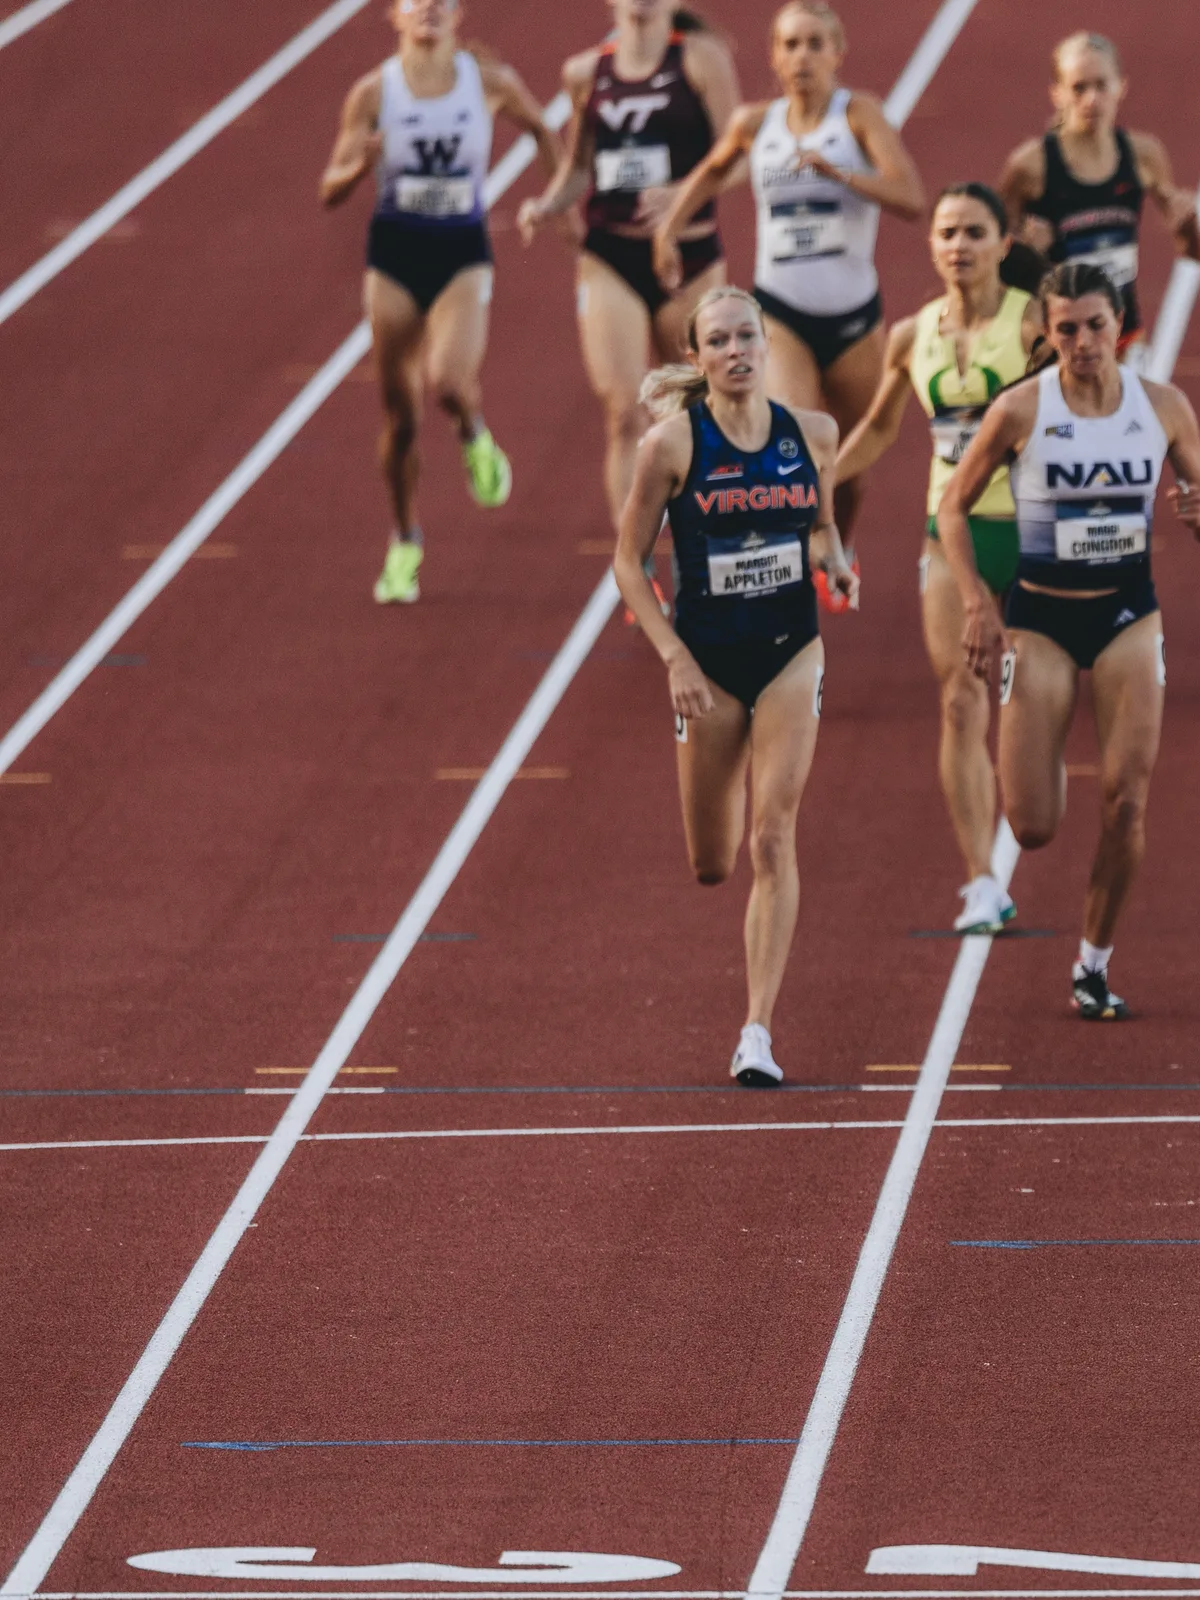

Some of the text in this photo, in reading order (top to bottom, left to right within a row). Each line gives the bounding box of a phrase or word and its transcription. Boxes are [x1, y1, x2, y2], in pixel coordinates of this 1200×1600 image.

[598, 94, 671, 132] VT
[409, 134, 461, 174] W
[1046, 460, 1152, 488] NAU
[693, 484, 818, 515] VIRGINIA
[724, 565, 792, 590] APPLETON
[127, 1546, 682, 1583] 3
